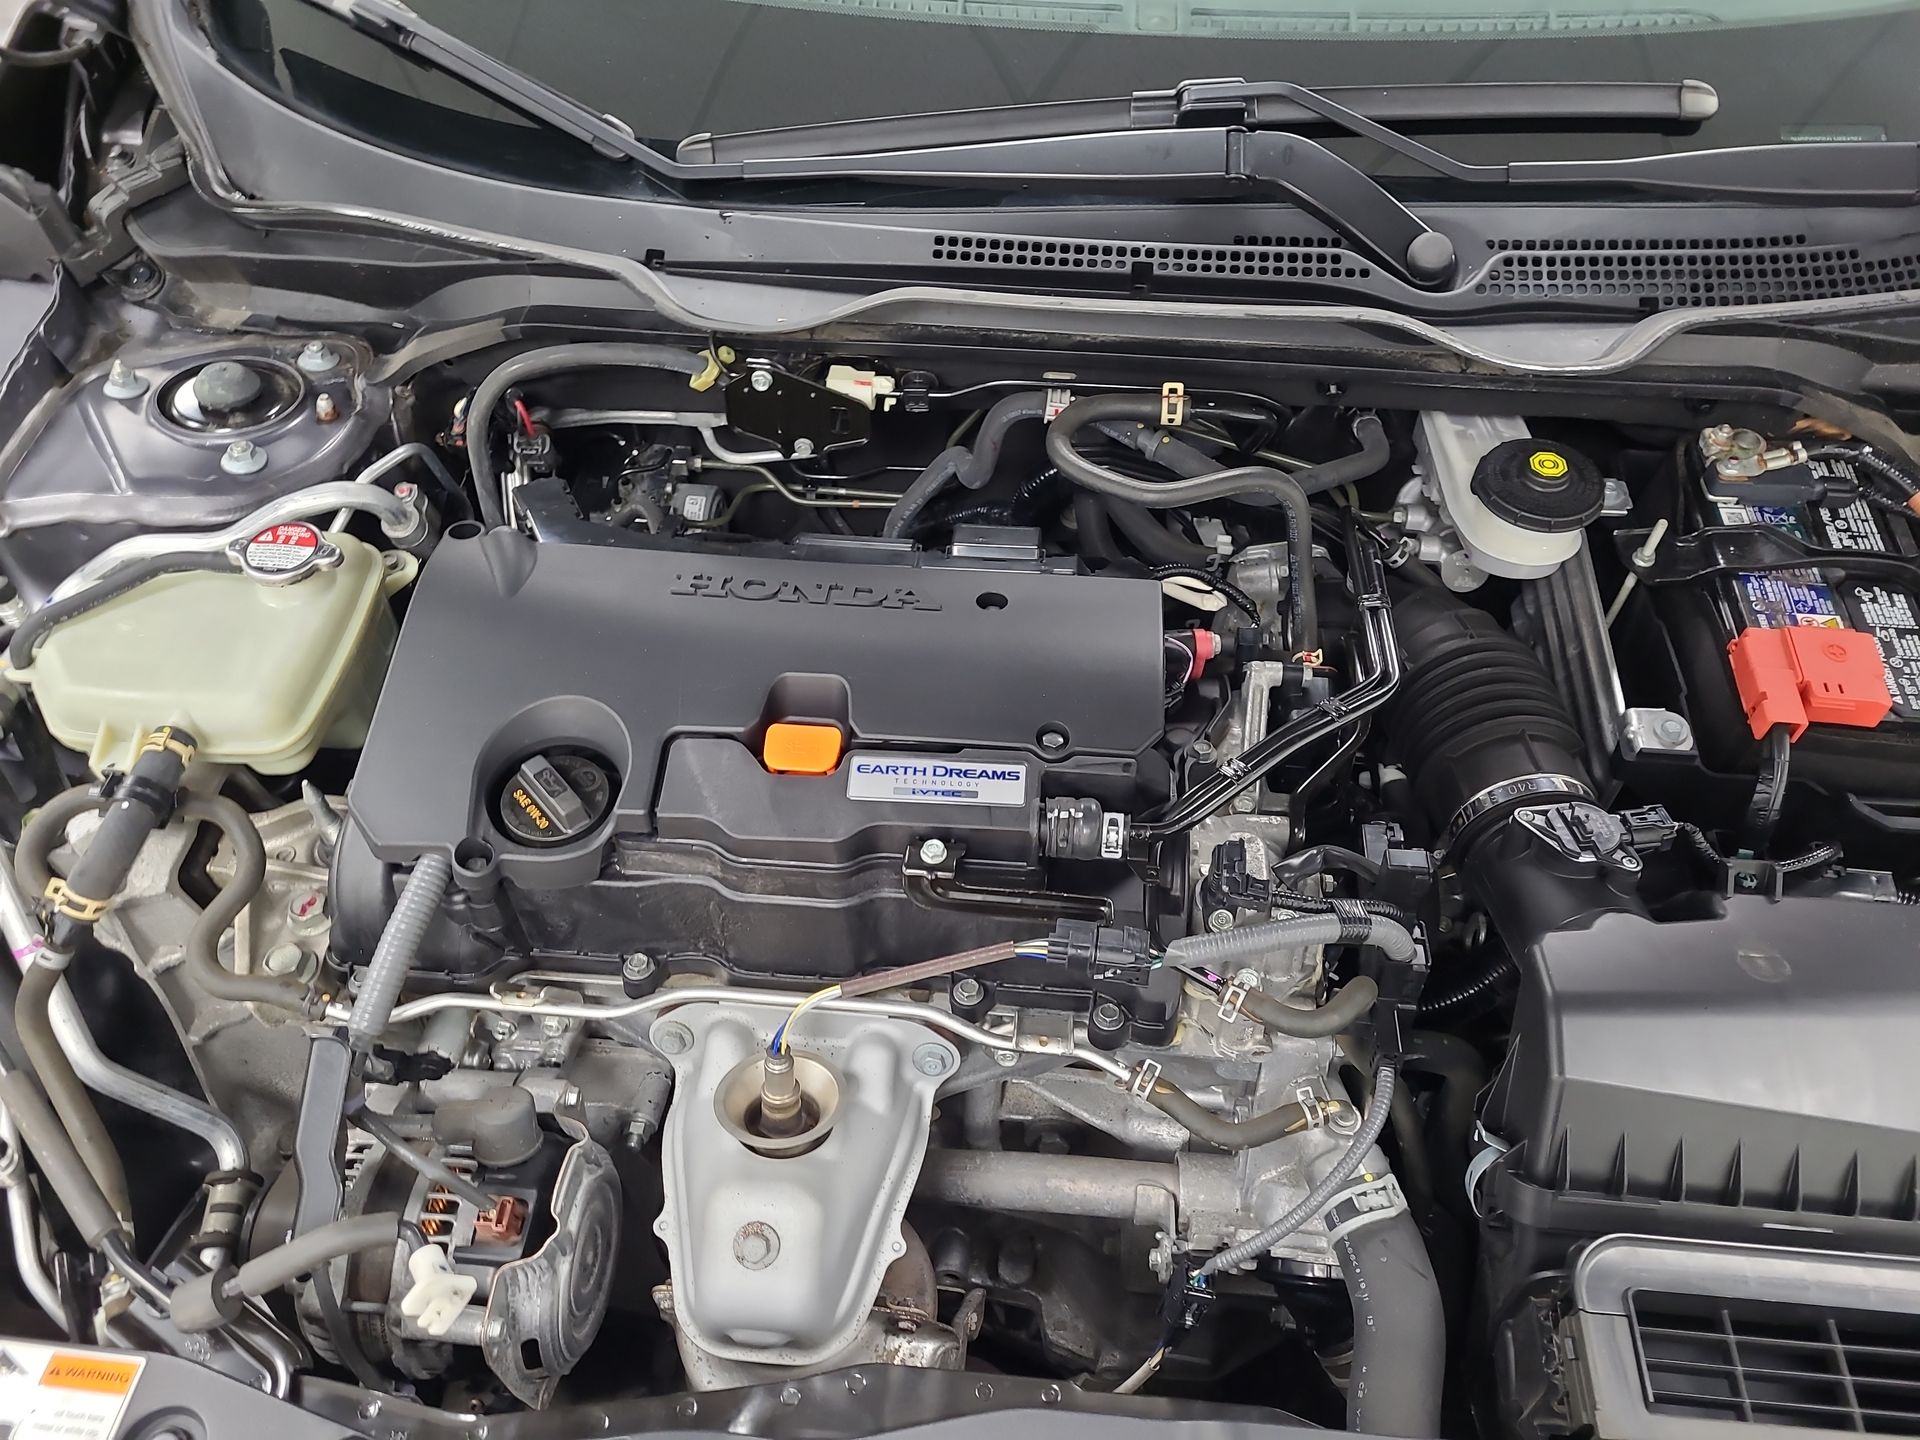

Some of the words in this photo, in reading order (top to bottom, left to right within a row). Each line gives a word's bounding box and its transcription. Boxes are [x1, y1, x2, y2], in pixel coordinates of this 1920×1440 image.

[670, 574, 943, 611] HONDA
[857, 764, 927, 777] EARTH
[932, 765, 1021, 781] DREAMS
[895, 778, 980, 788] TECHNOLOGY
[513, 789, 532, 809] SAE
[526, 804, 550, 829] 0W-20
[65, 1367, 130, 1384] WARNING
